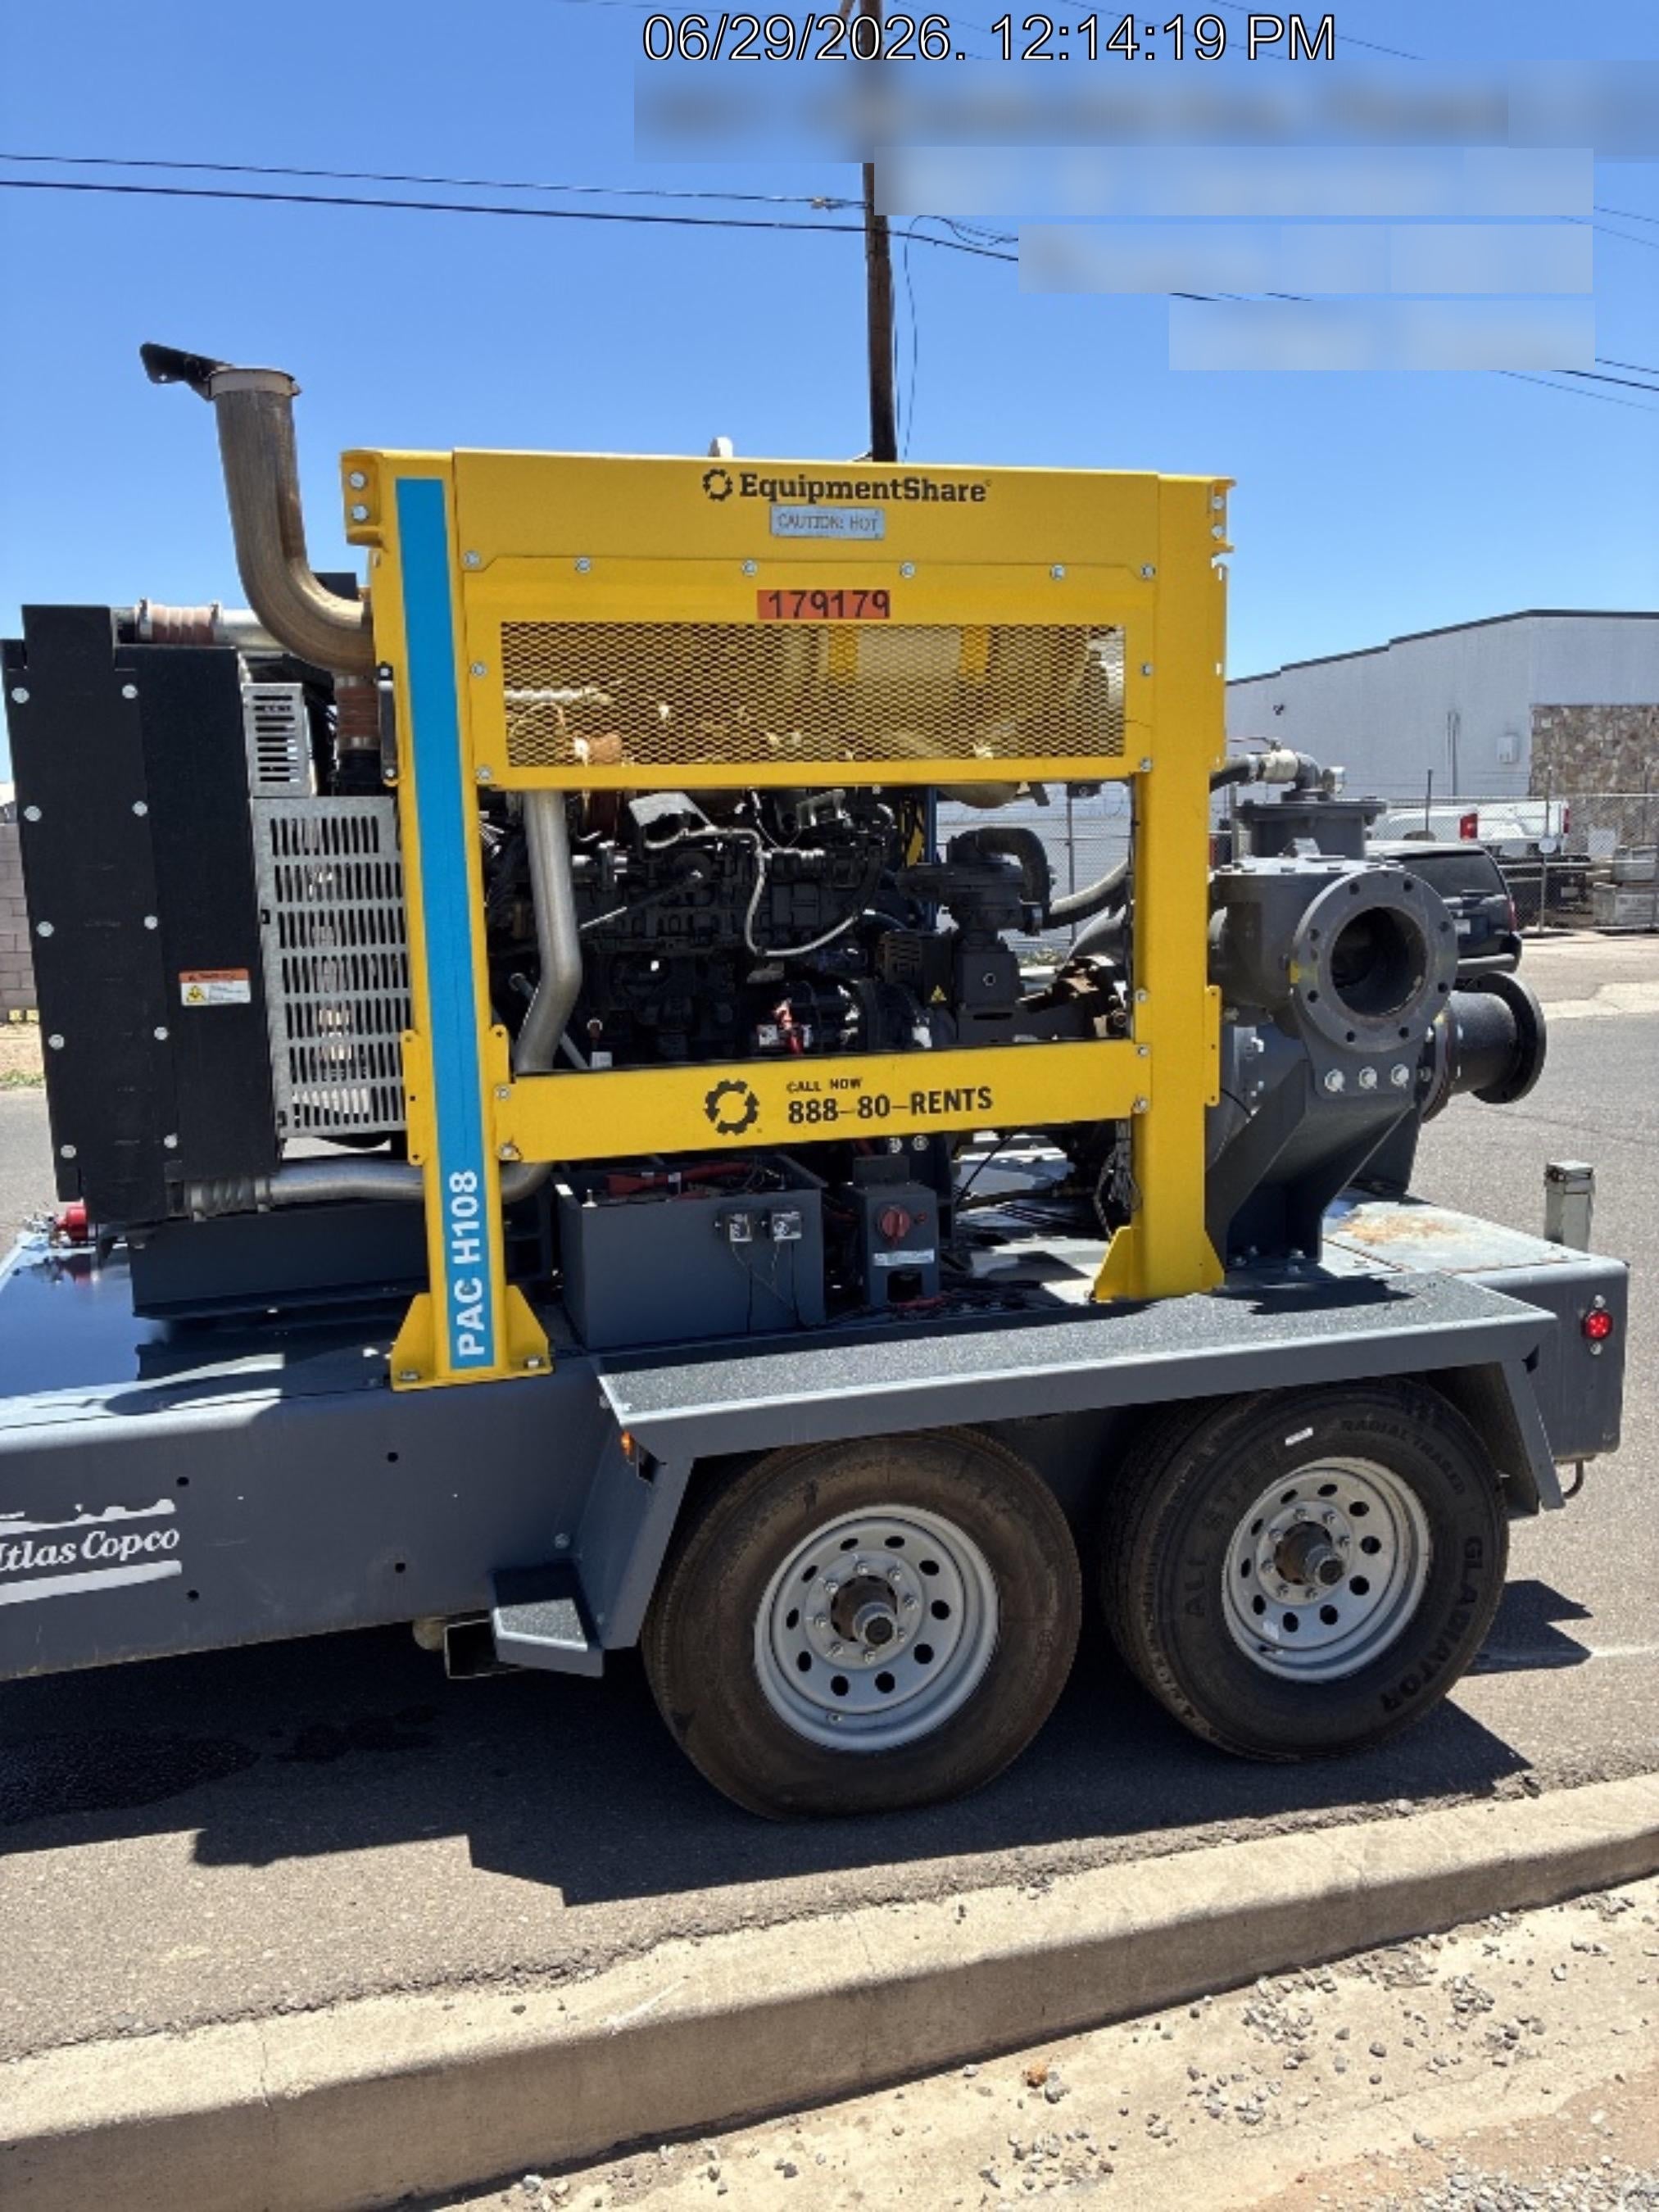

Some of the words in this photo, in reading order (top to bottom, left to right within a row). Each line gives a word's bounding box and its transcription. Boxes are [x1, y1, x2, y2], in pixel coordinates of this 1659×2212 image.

[739, 473, 987, 504] EquipmentShare
[777, 512, 845, 531] CAUTION:
[850, 515, 879, 533] HOT
[768, 590, 890, 619] 179179
[786, 1080, 822, 1094] CALL
[829, 1077, 863, 1090] NOW
[787, 1086, 994, 1125] 888-80-RENTS
[449, 1169, 482, 1264] H108
[454, 1277, 485, 1357] PAC
[81, 1528, 180, 1562] Copco
[1380, 1535, 1484, 1713] GLADIATOR
